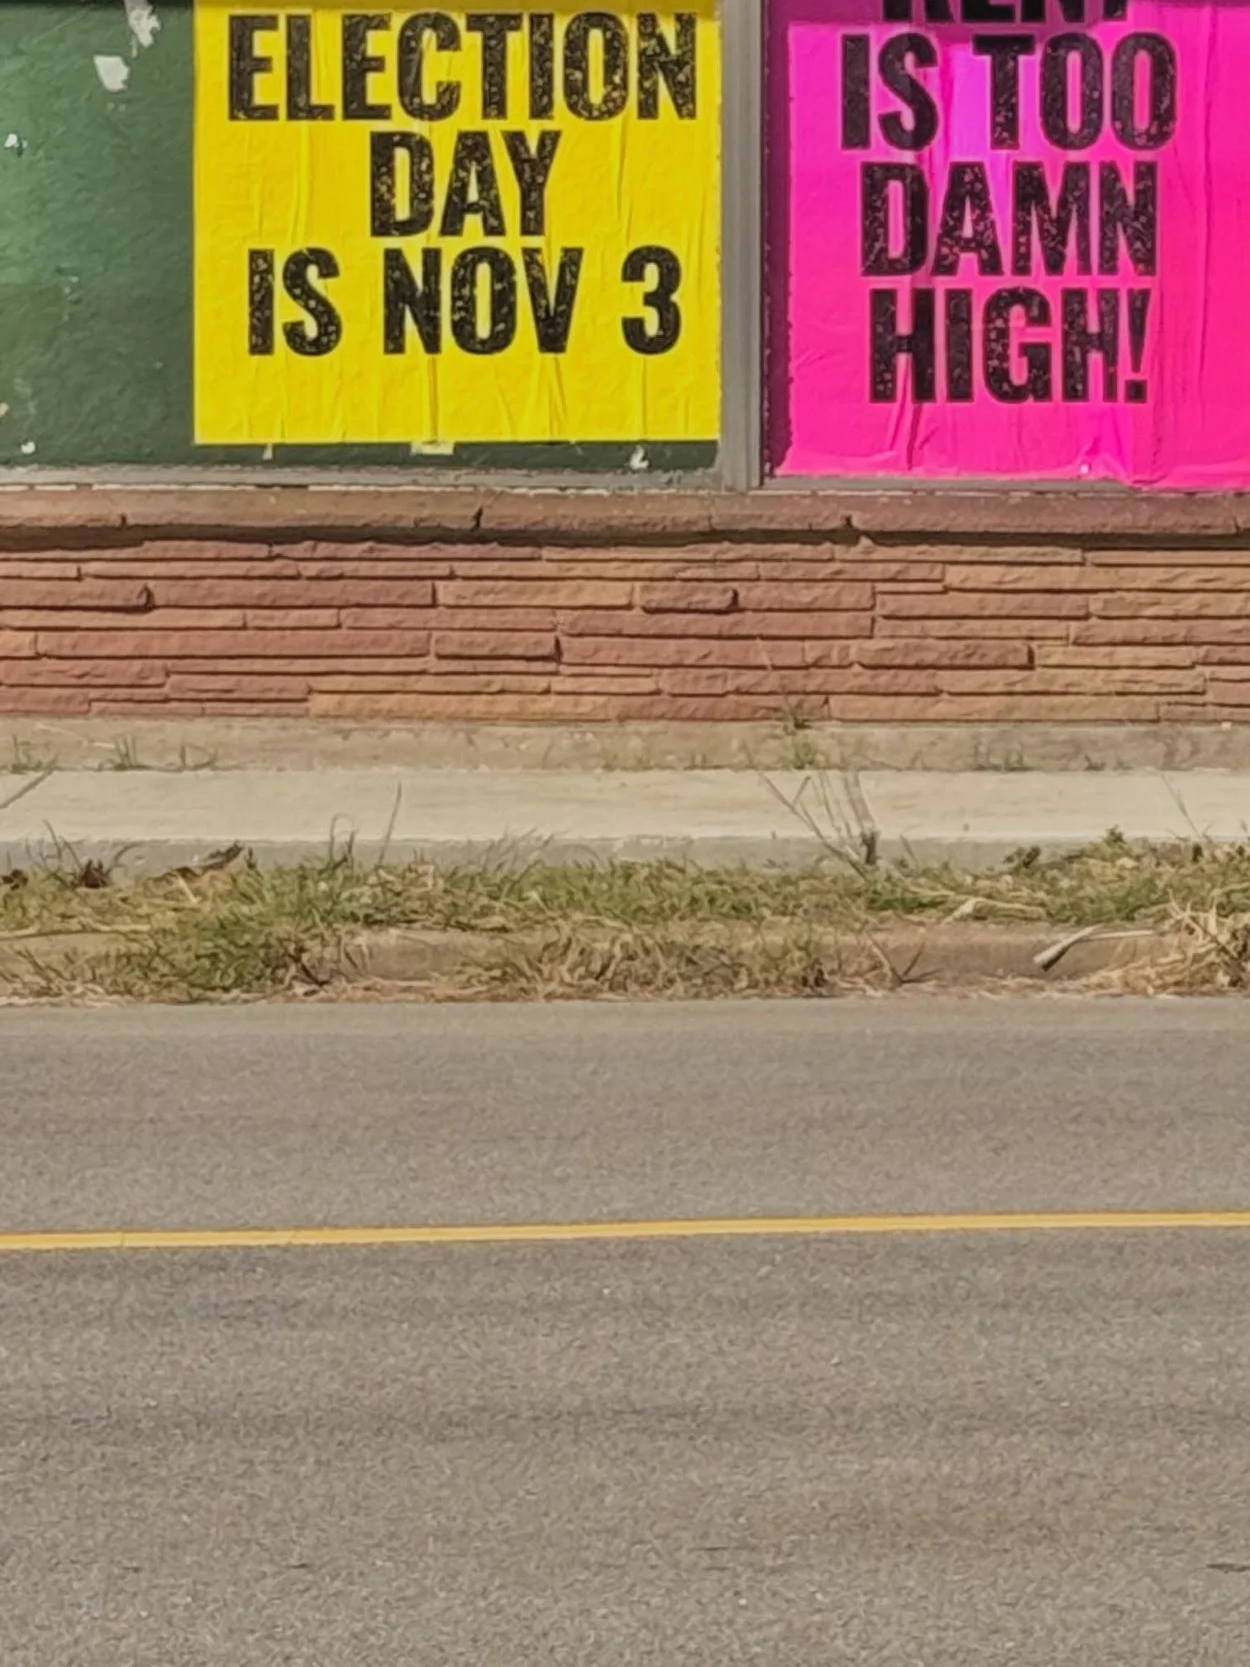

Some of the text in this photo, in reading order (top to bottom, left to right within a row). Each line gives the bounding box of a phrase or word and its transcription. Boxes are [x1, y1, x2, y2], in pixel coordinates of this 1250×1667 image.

[227, 13, 697, 122] ELECTION
[841, 33, 1177, 151] IS TOO
[370, 131, 561, 236] DAY
[861, 162, 1157, 277] DAMN
[248, 246, 682, 355] IS NOV 3
[870, 289, 1150, 404] HIGH!
